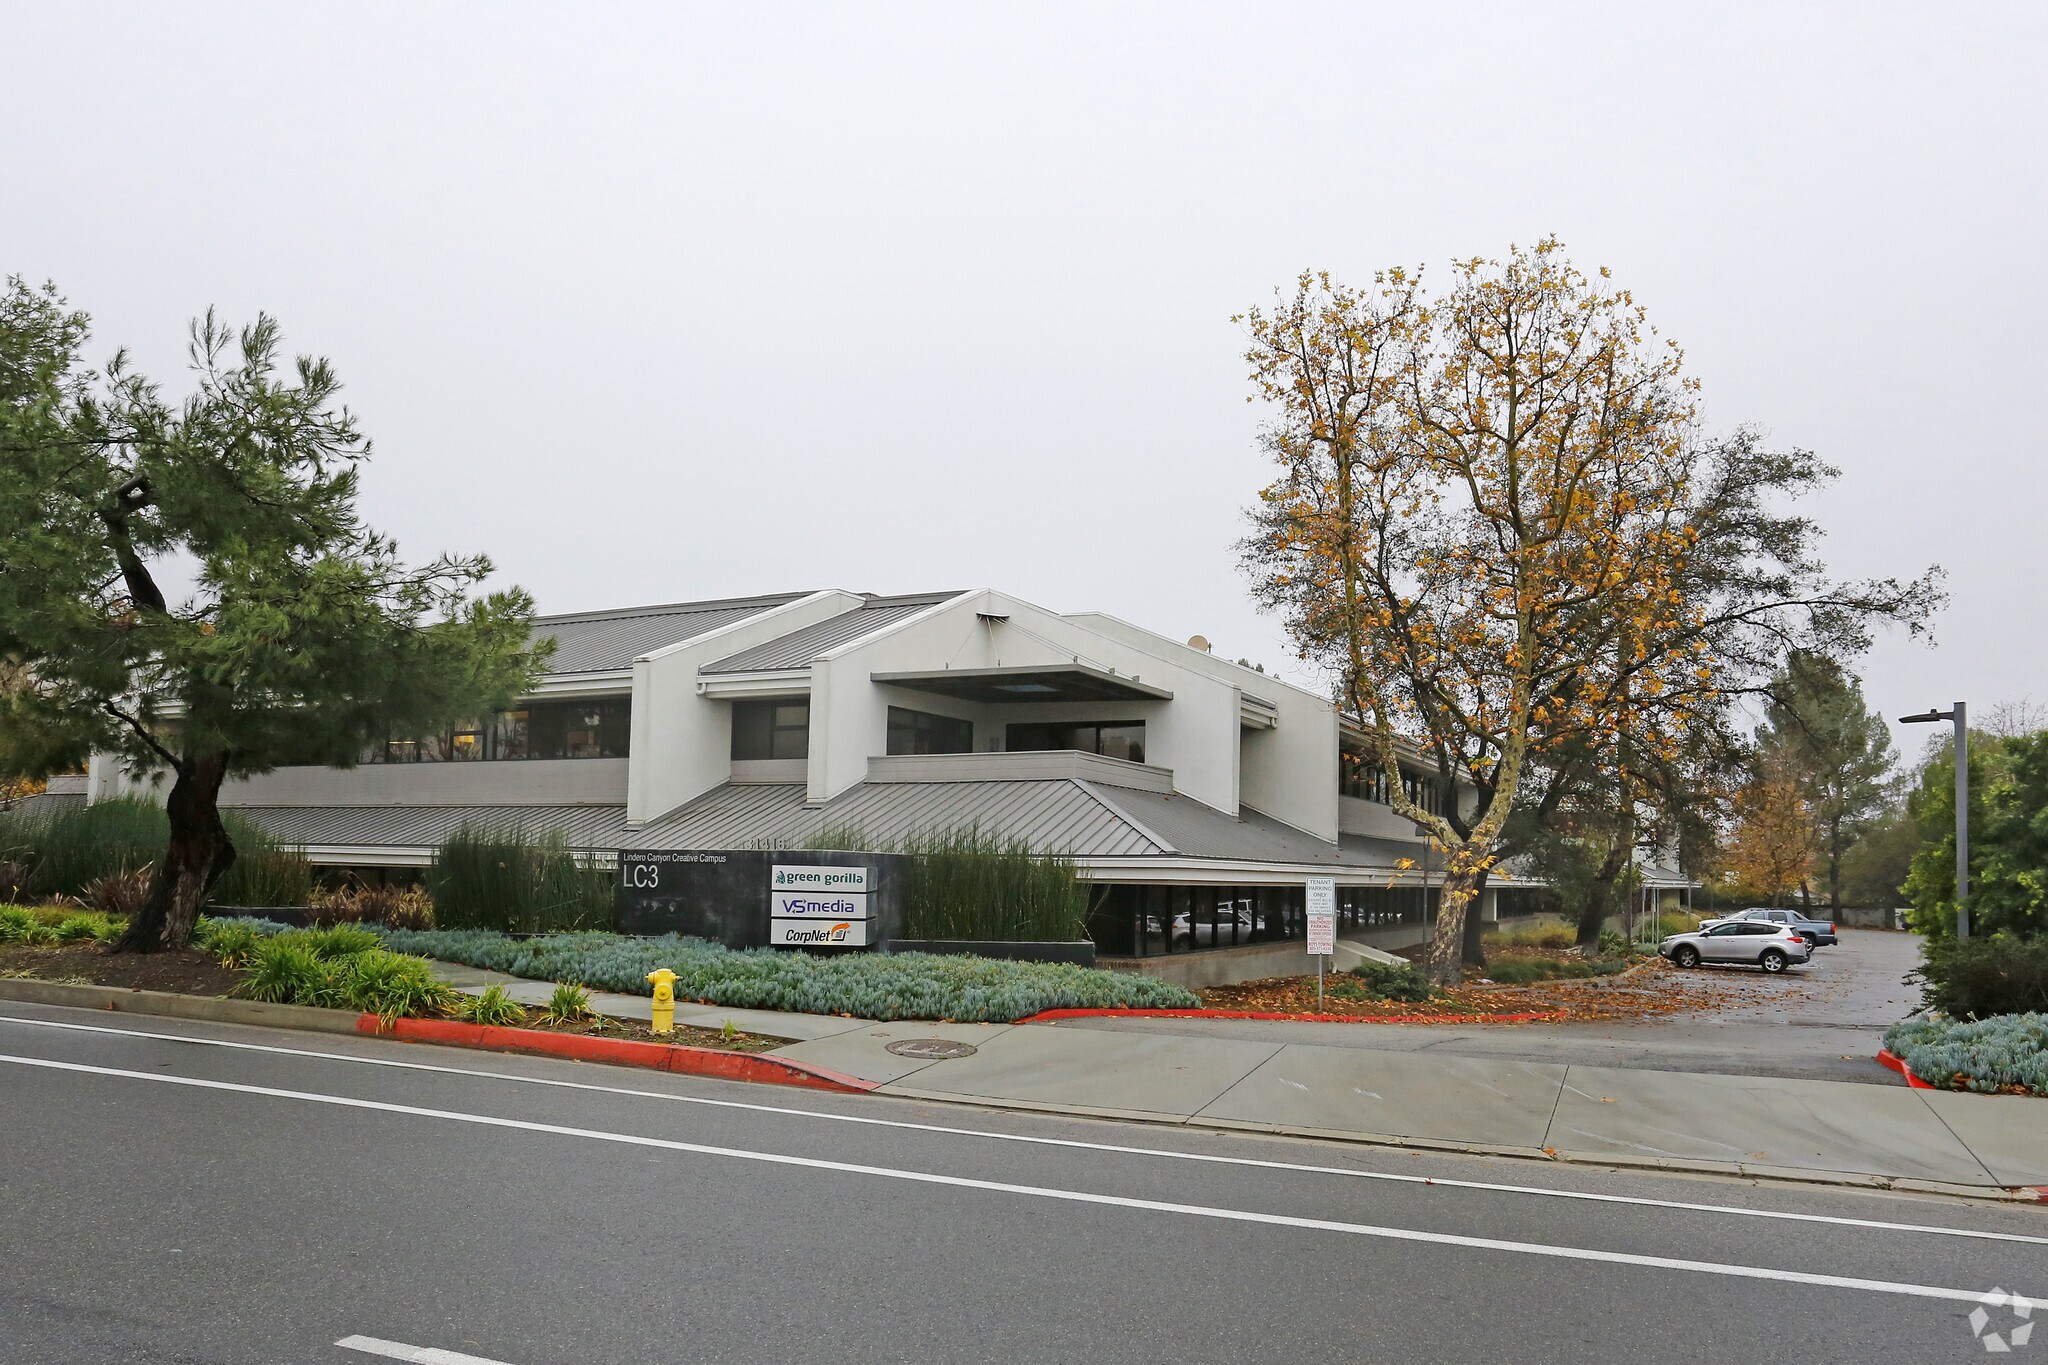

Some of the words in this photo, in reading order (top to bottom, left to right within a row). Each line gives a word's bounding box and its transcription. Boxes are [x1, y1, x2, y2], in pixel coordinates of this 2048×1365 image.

[746, 838, 787, 850] 31416
[623, 853, 646, 862] Lindero
[647, 853, 671, 863] Canyon
[672, 853, 698, 862] Creative
[699, 853, 727, 864] Campus
[623, 864, 659, 888] LC3
[786, 873, 821, 884] green
[824, 873, 864, 886] gorilla
[782, 899, 855, 914] VSmedia
[786, 929, 832, 943] CorpNet
